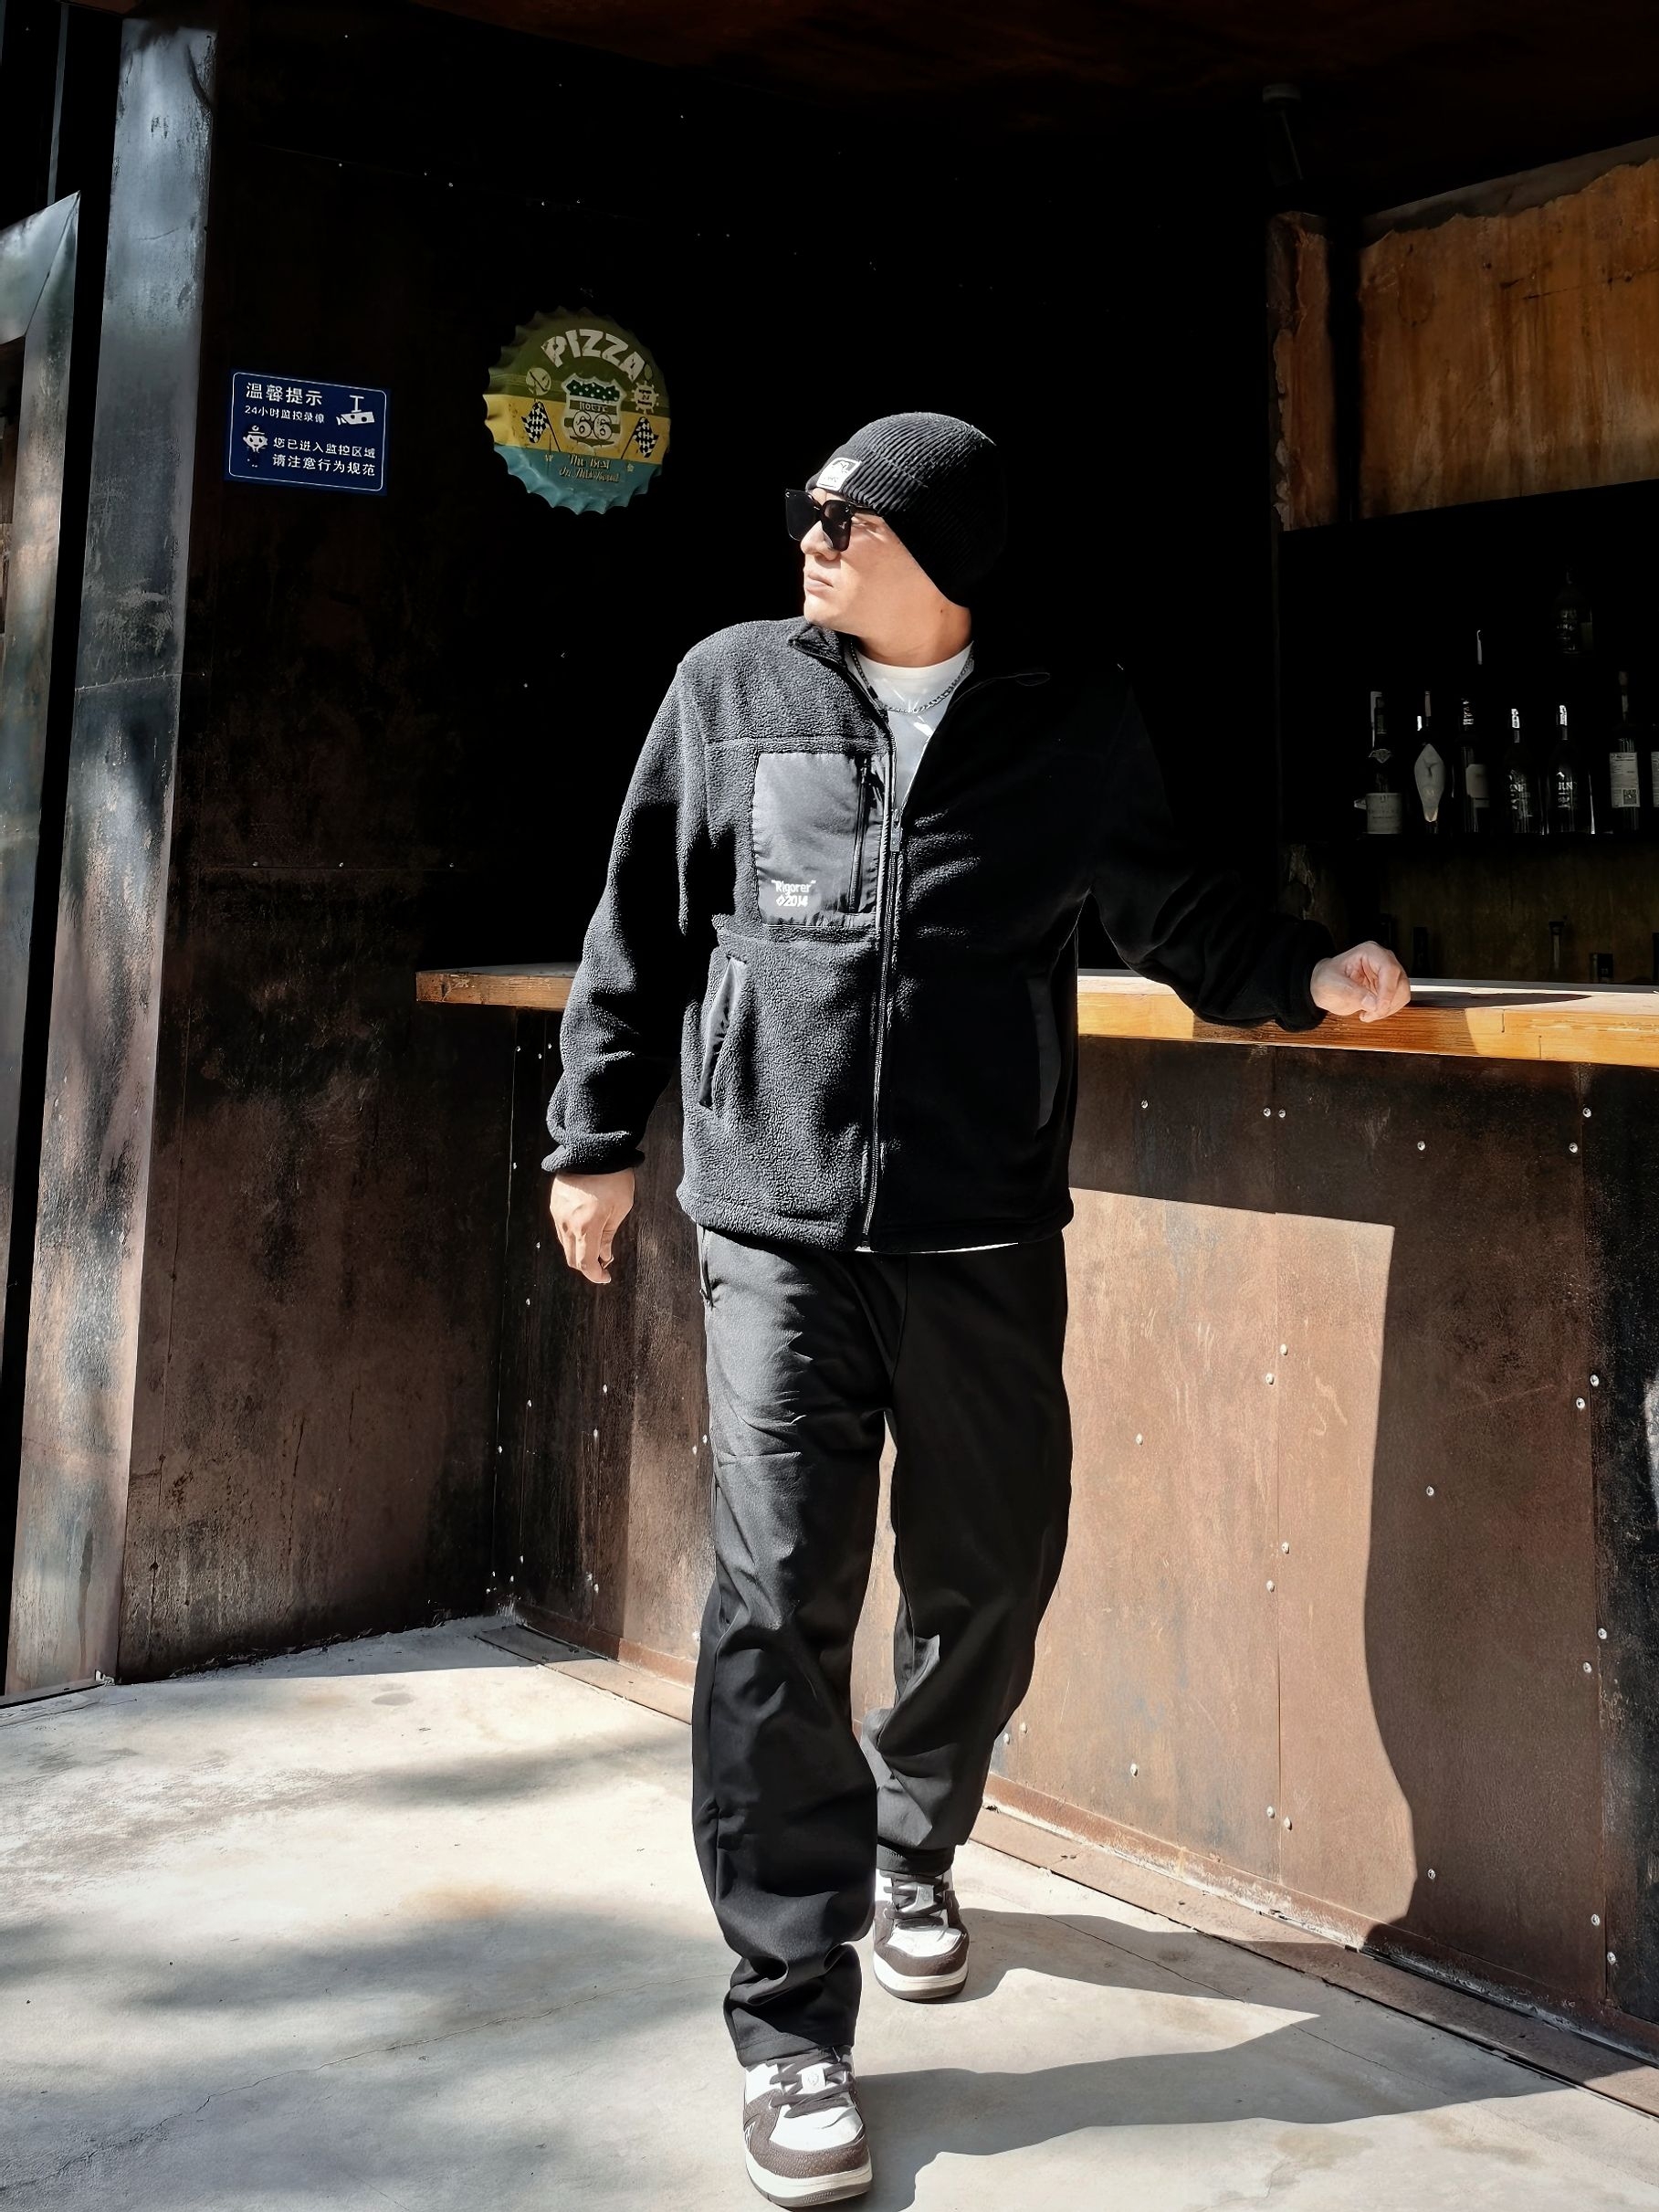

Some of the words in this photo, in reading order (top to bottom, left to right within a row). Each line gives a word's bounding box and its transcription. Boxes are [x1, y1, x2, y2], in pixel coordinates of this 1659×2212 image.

[541, 328, 646, 383] PIZZA
[246, 382, 322, 406] 温馨提示
[245, 405, 325, 424] 24小时监控录像
[572, 410, 612, 440] 66
[273, 437, 376, 458] 您已进入监控区域
[272, 453, 375, 477] 请注意行为规范
